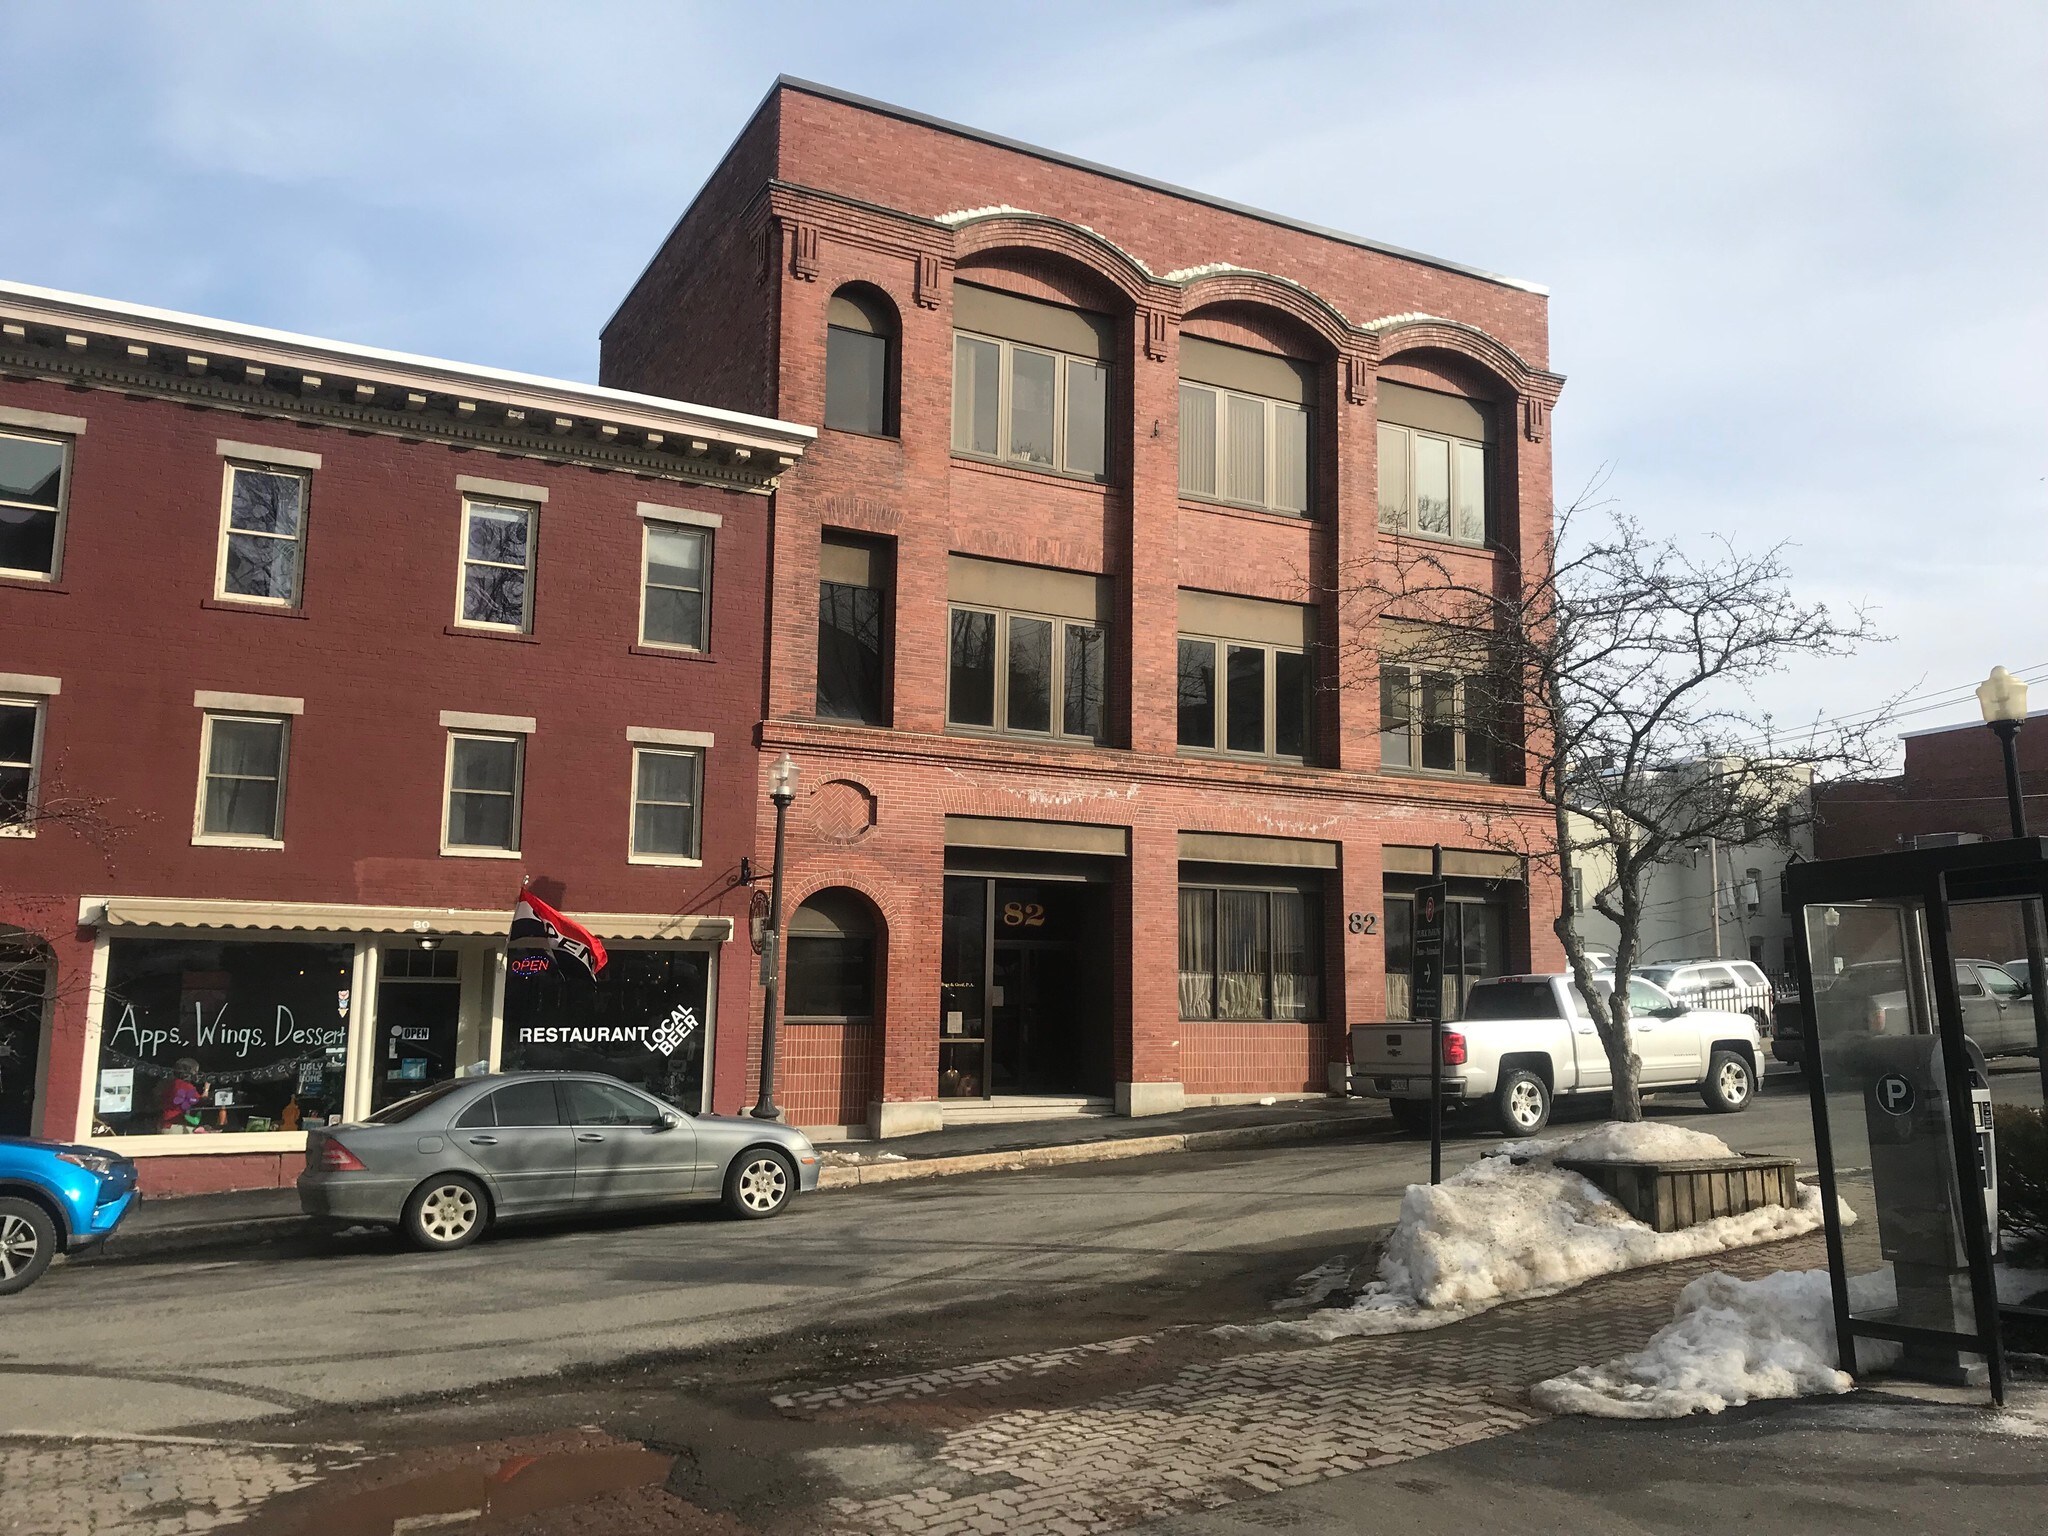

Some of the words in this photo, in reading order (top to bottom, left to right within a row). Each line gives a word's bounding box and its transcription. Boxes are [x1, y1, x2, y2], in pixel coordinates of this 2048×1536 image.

[413, 920, 430, 929] 80
[1003, 902, 1045, 926] 82
[1348, 912, 1378, 935] 82
[511, 960, 550, 971] OPEN
[196, 1001, 267, 1058] Wings,
[275, 1004, 346, 1047] Dessert
[404, 1028, 428, 1039] OPEN
[519, 1026, 649, 1043] RESTAURANT
[643, 1004, 693, 1052] LOCAL
[658, 1014, 699, 1057] BEER
[299, 1062, 323, 1071] UGLY
[1886, 1079, 1907, 1107] P
